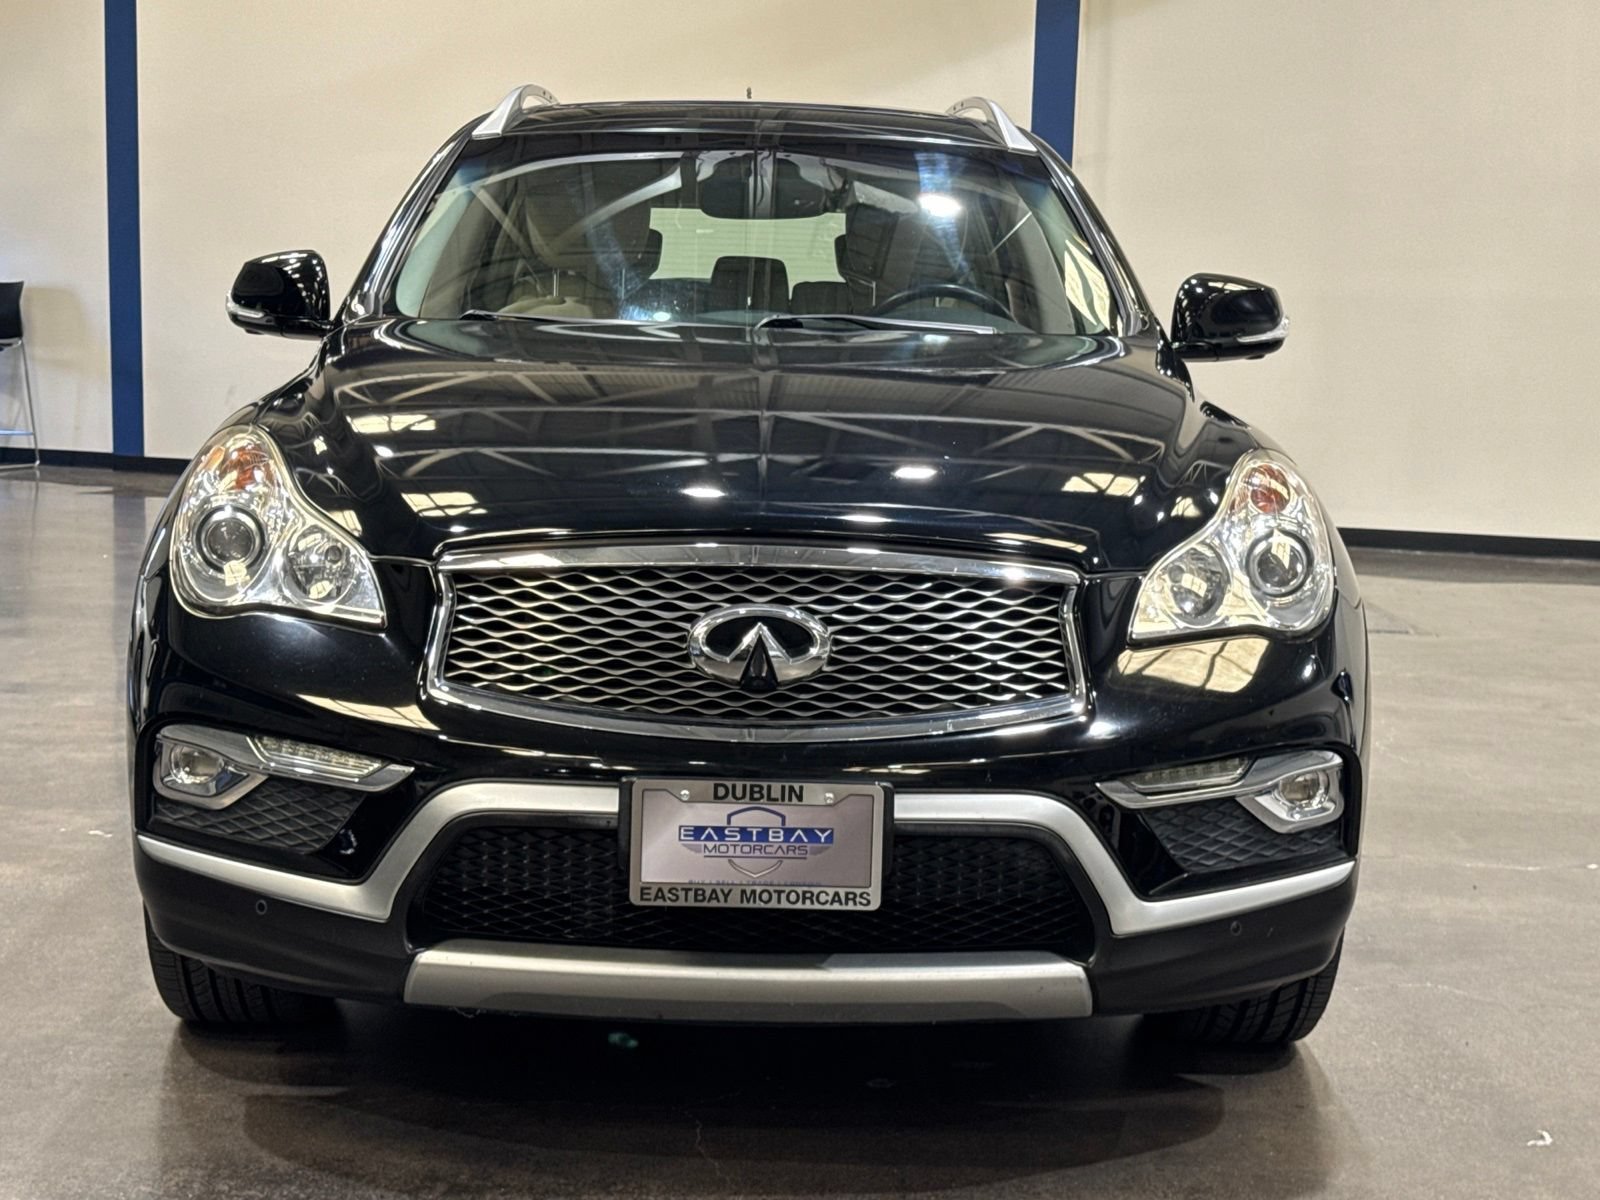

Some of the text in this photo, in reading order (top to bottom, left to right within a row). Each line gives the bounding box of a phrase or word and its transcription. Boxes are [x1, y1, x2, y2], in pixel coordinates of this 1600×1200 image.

[713, 783, 804, 803] DUBLIN
[680, 826, 833, 843] EASTBAY
[703, 843, 808, 856] MOTORCARS
[639, 887, 871, 906] EASTBAY MOTORCARS
